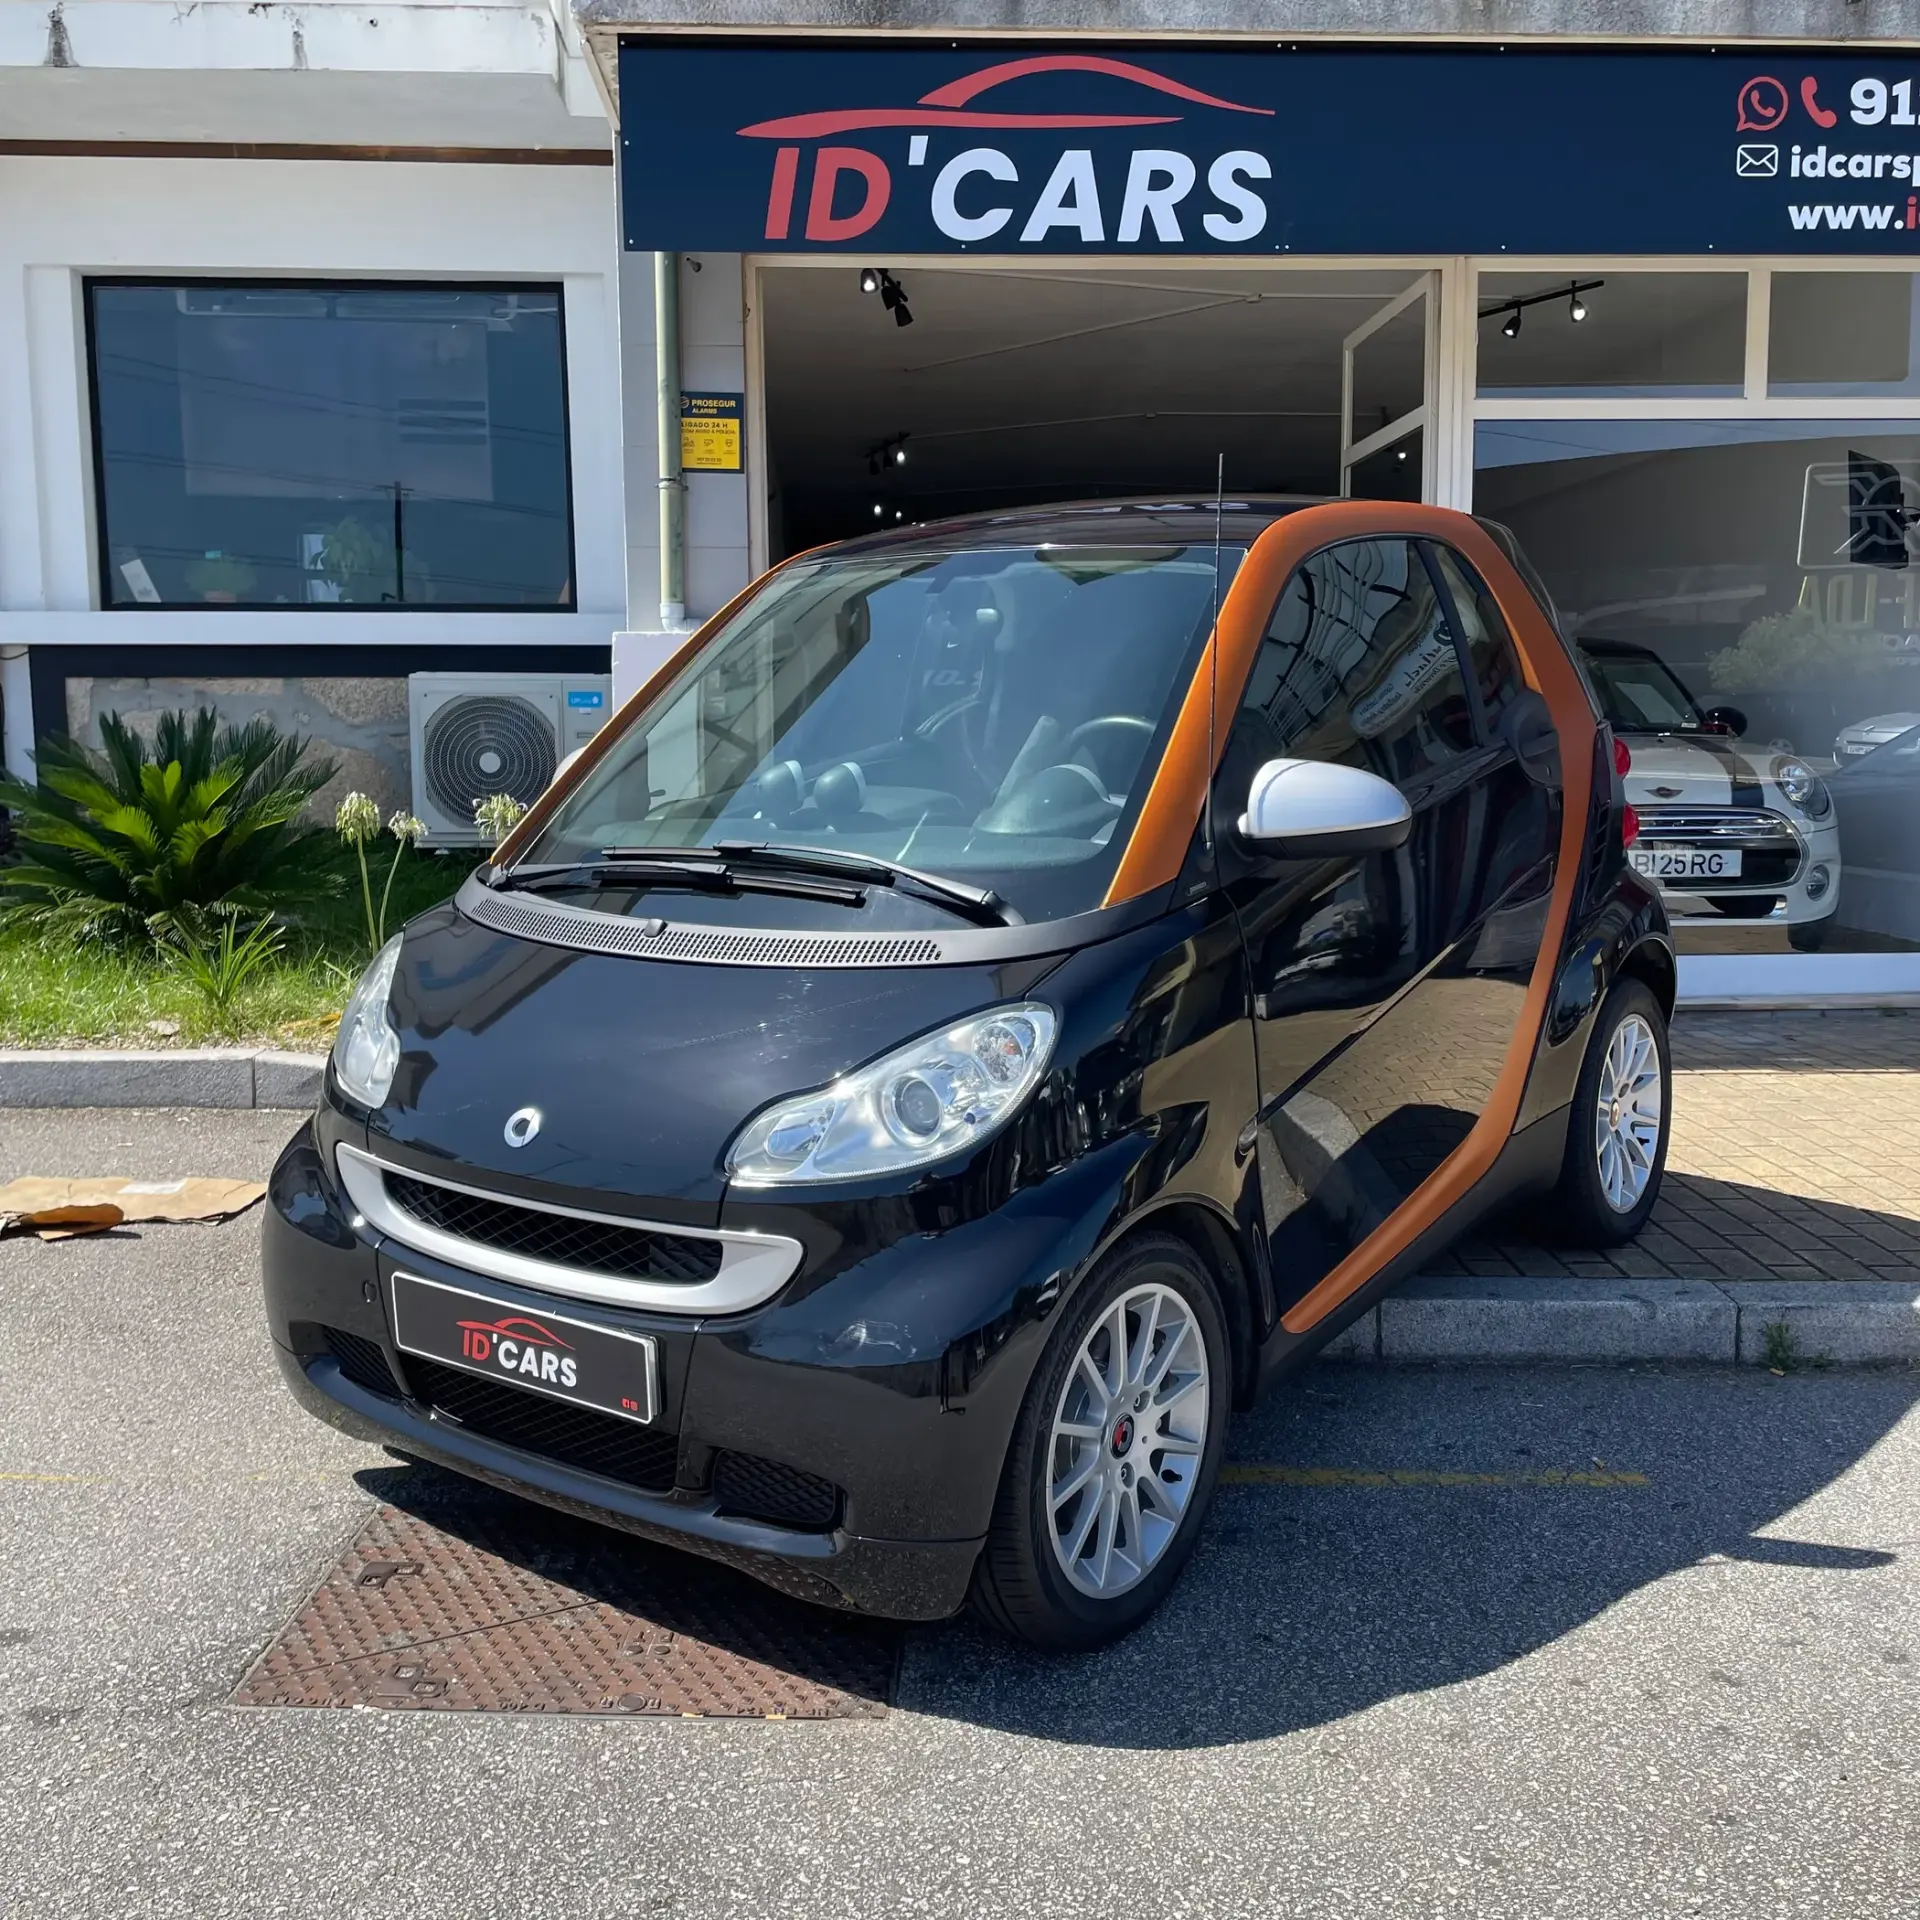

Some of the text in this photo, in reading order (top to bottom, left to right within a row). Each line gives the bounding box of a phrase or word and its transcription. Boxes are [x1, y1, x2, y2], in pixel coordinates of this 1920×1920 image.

[1850, 77, 1920, 126] 91
[765, 135, 1272, 242] ID'CARS
[1788, 195, 1920, 230] www.i
[691, 399, 736, 408] PROSEGUR
[462, 1329, 577, 1388] ID'CARS
